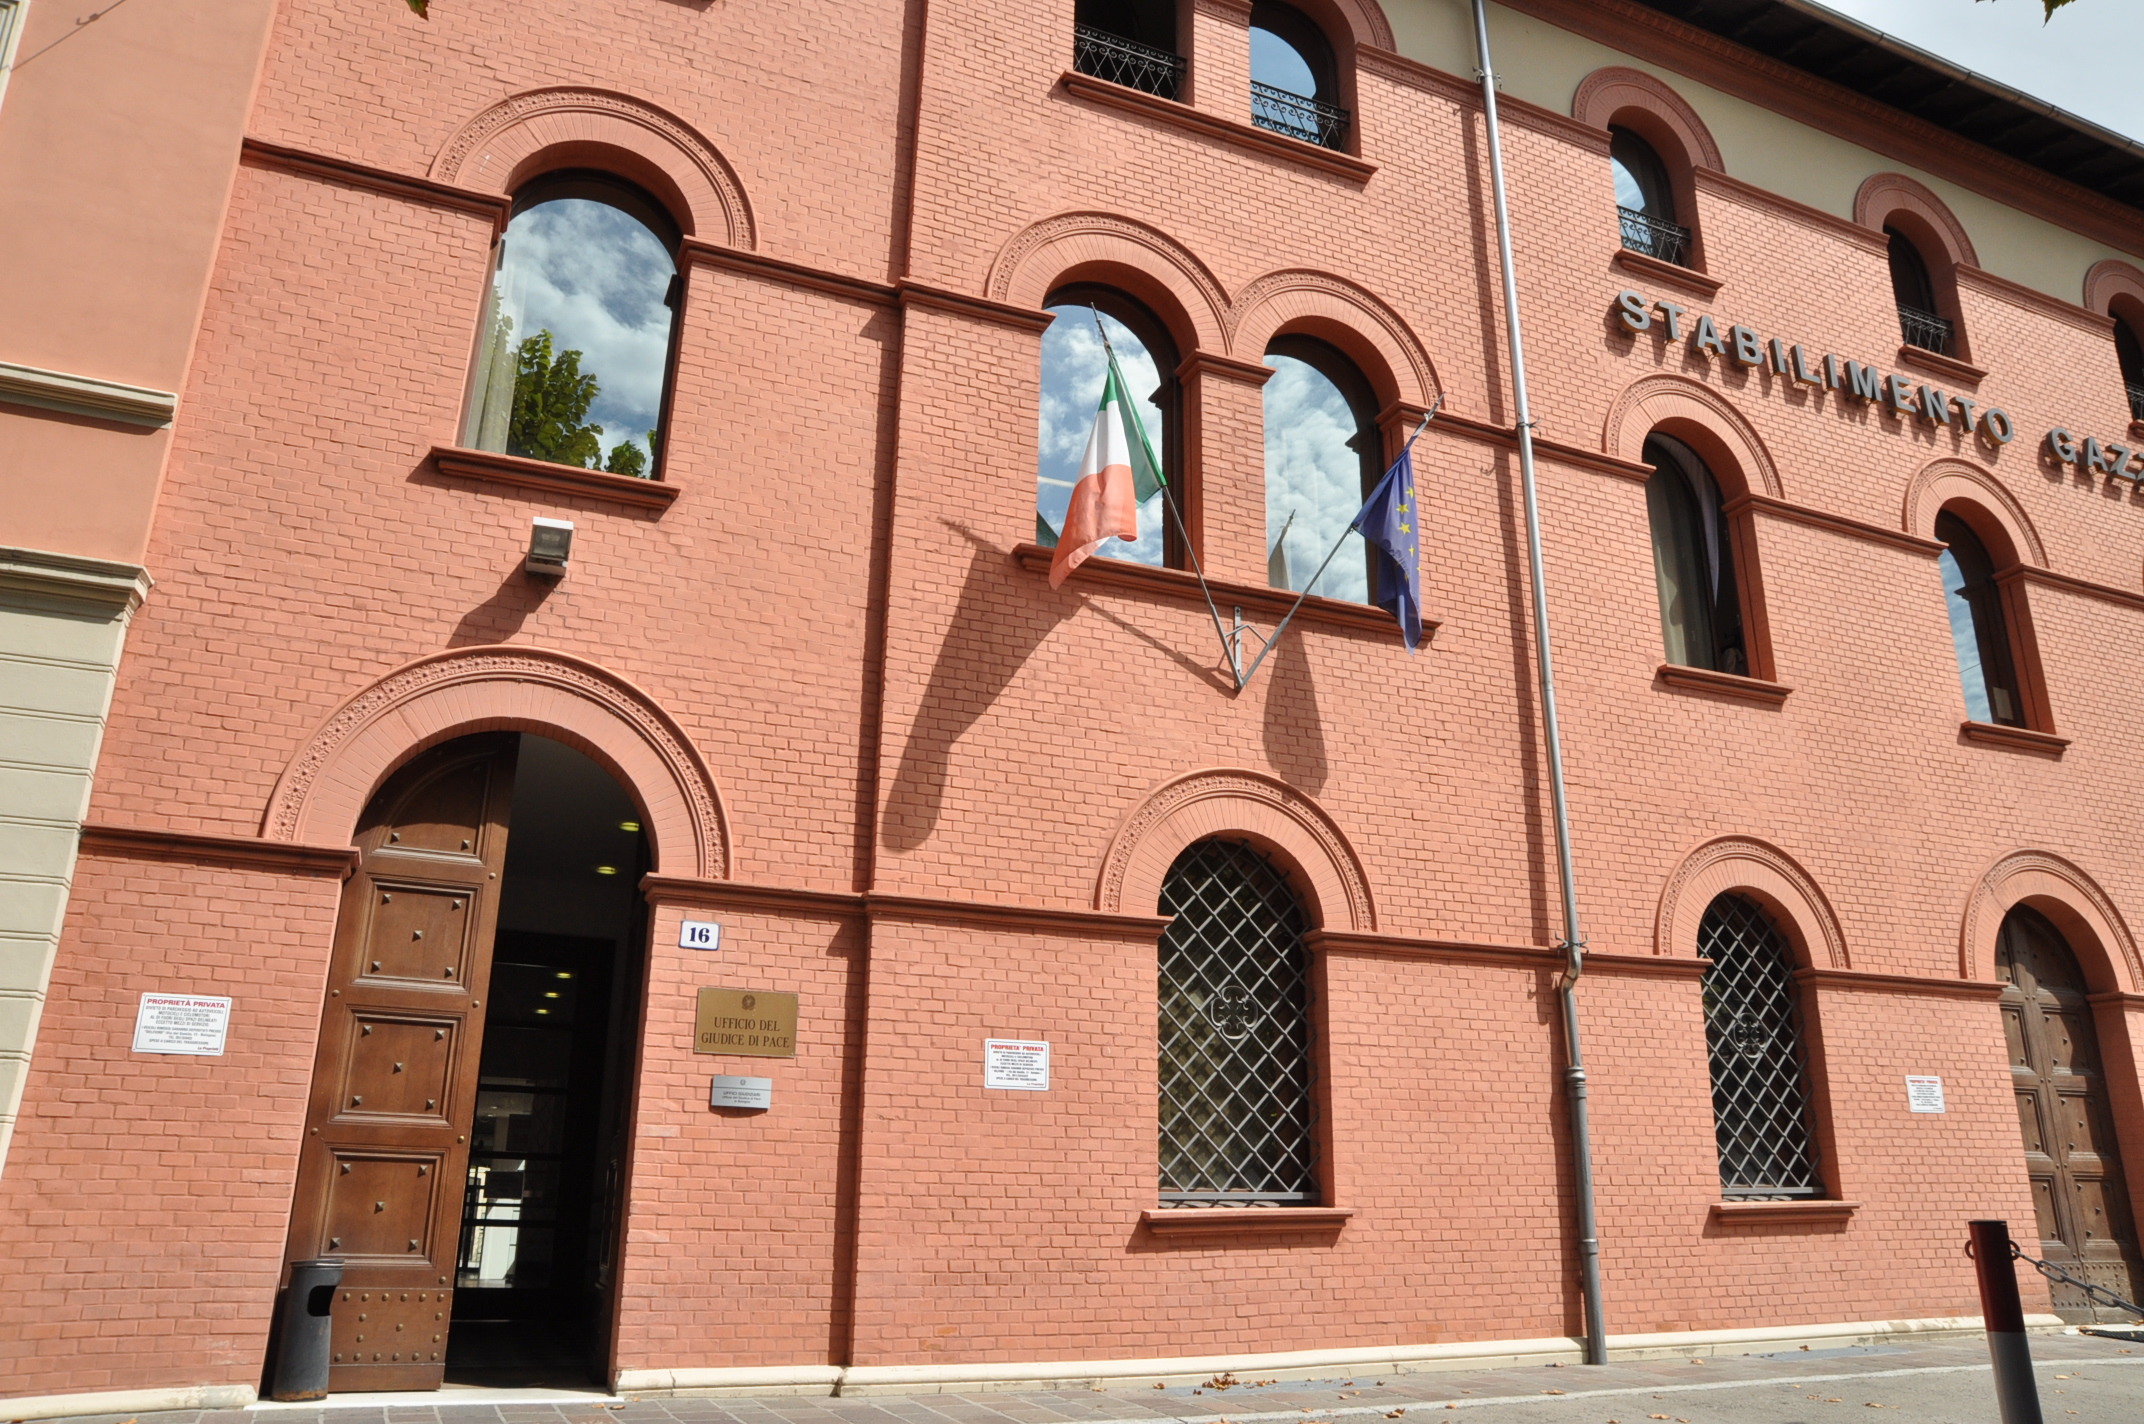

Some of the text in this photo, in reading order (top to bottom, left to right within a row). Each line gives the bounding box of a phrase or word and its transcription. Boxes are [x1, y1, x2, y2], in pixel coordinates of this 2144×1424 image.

[1617, 289, 2144, 482] STABILIMENTO GAZ
[689, 927, 710, 944] 16
[147, 998, 226, 1009] PROPRIETÀ PRIVATA
[714, 1017, 780, 1032] UFFICIO DEL
[701, 1032, 790, 1048] GIUDICE DI PACE
